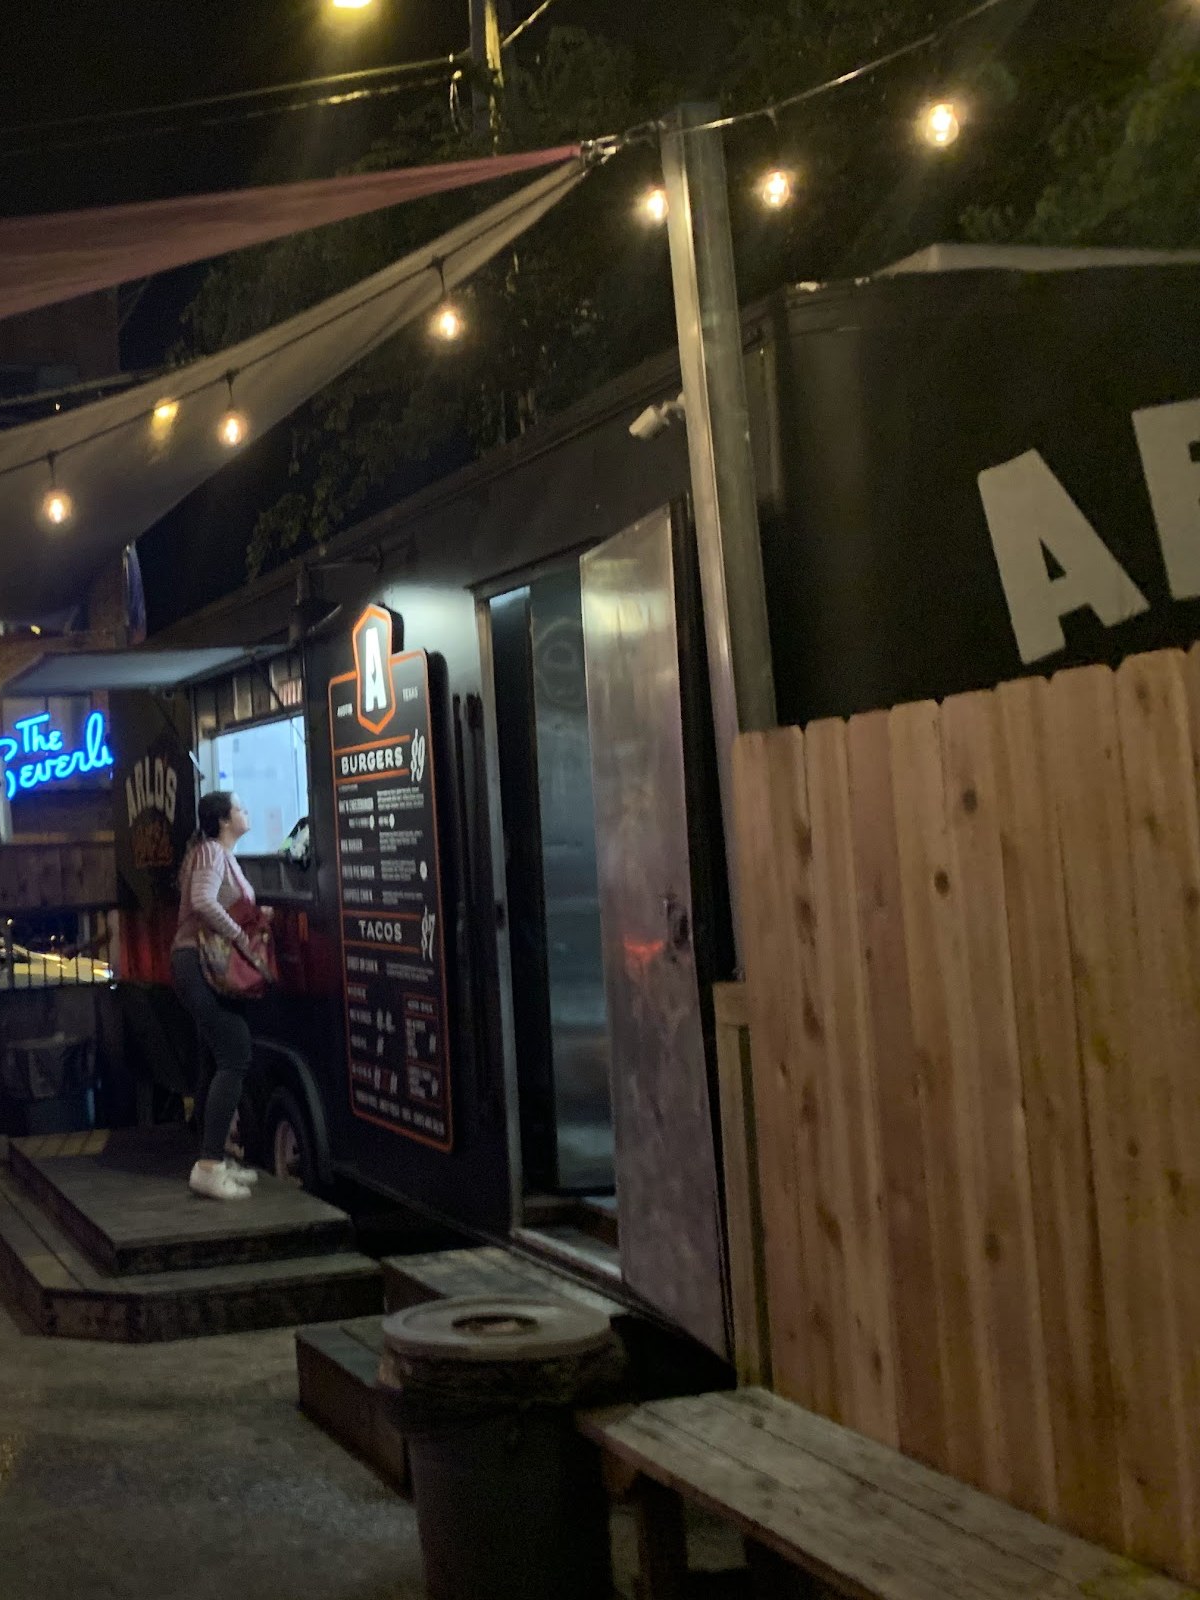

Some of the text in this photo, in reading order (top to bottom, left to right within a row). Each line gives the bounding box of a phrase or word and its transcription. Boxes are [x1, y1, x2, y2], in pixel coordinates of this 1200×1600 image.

[365, 627, 388, 713] A
[15, 712, 63, 753] The
[341, 728, 426, 782] BURGERS $9
[358, 920, 403, 943] TACOS
